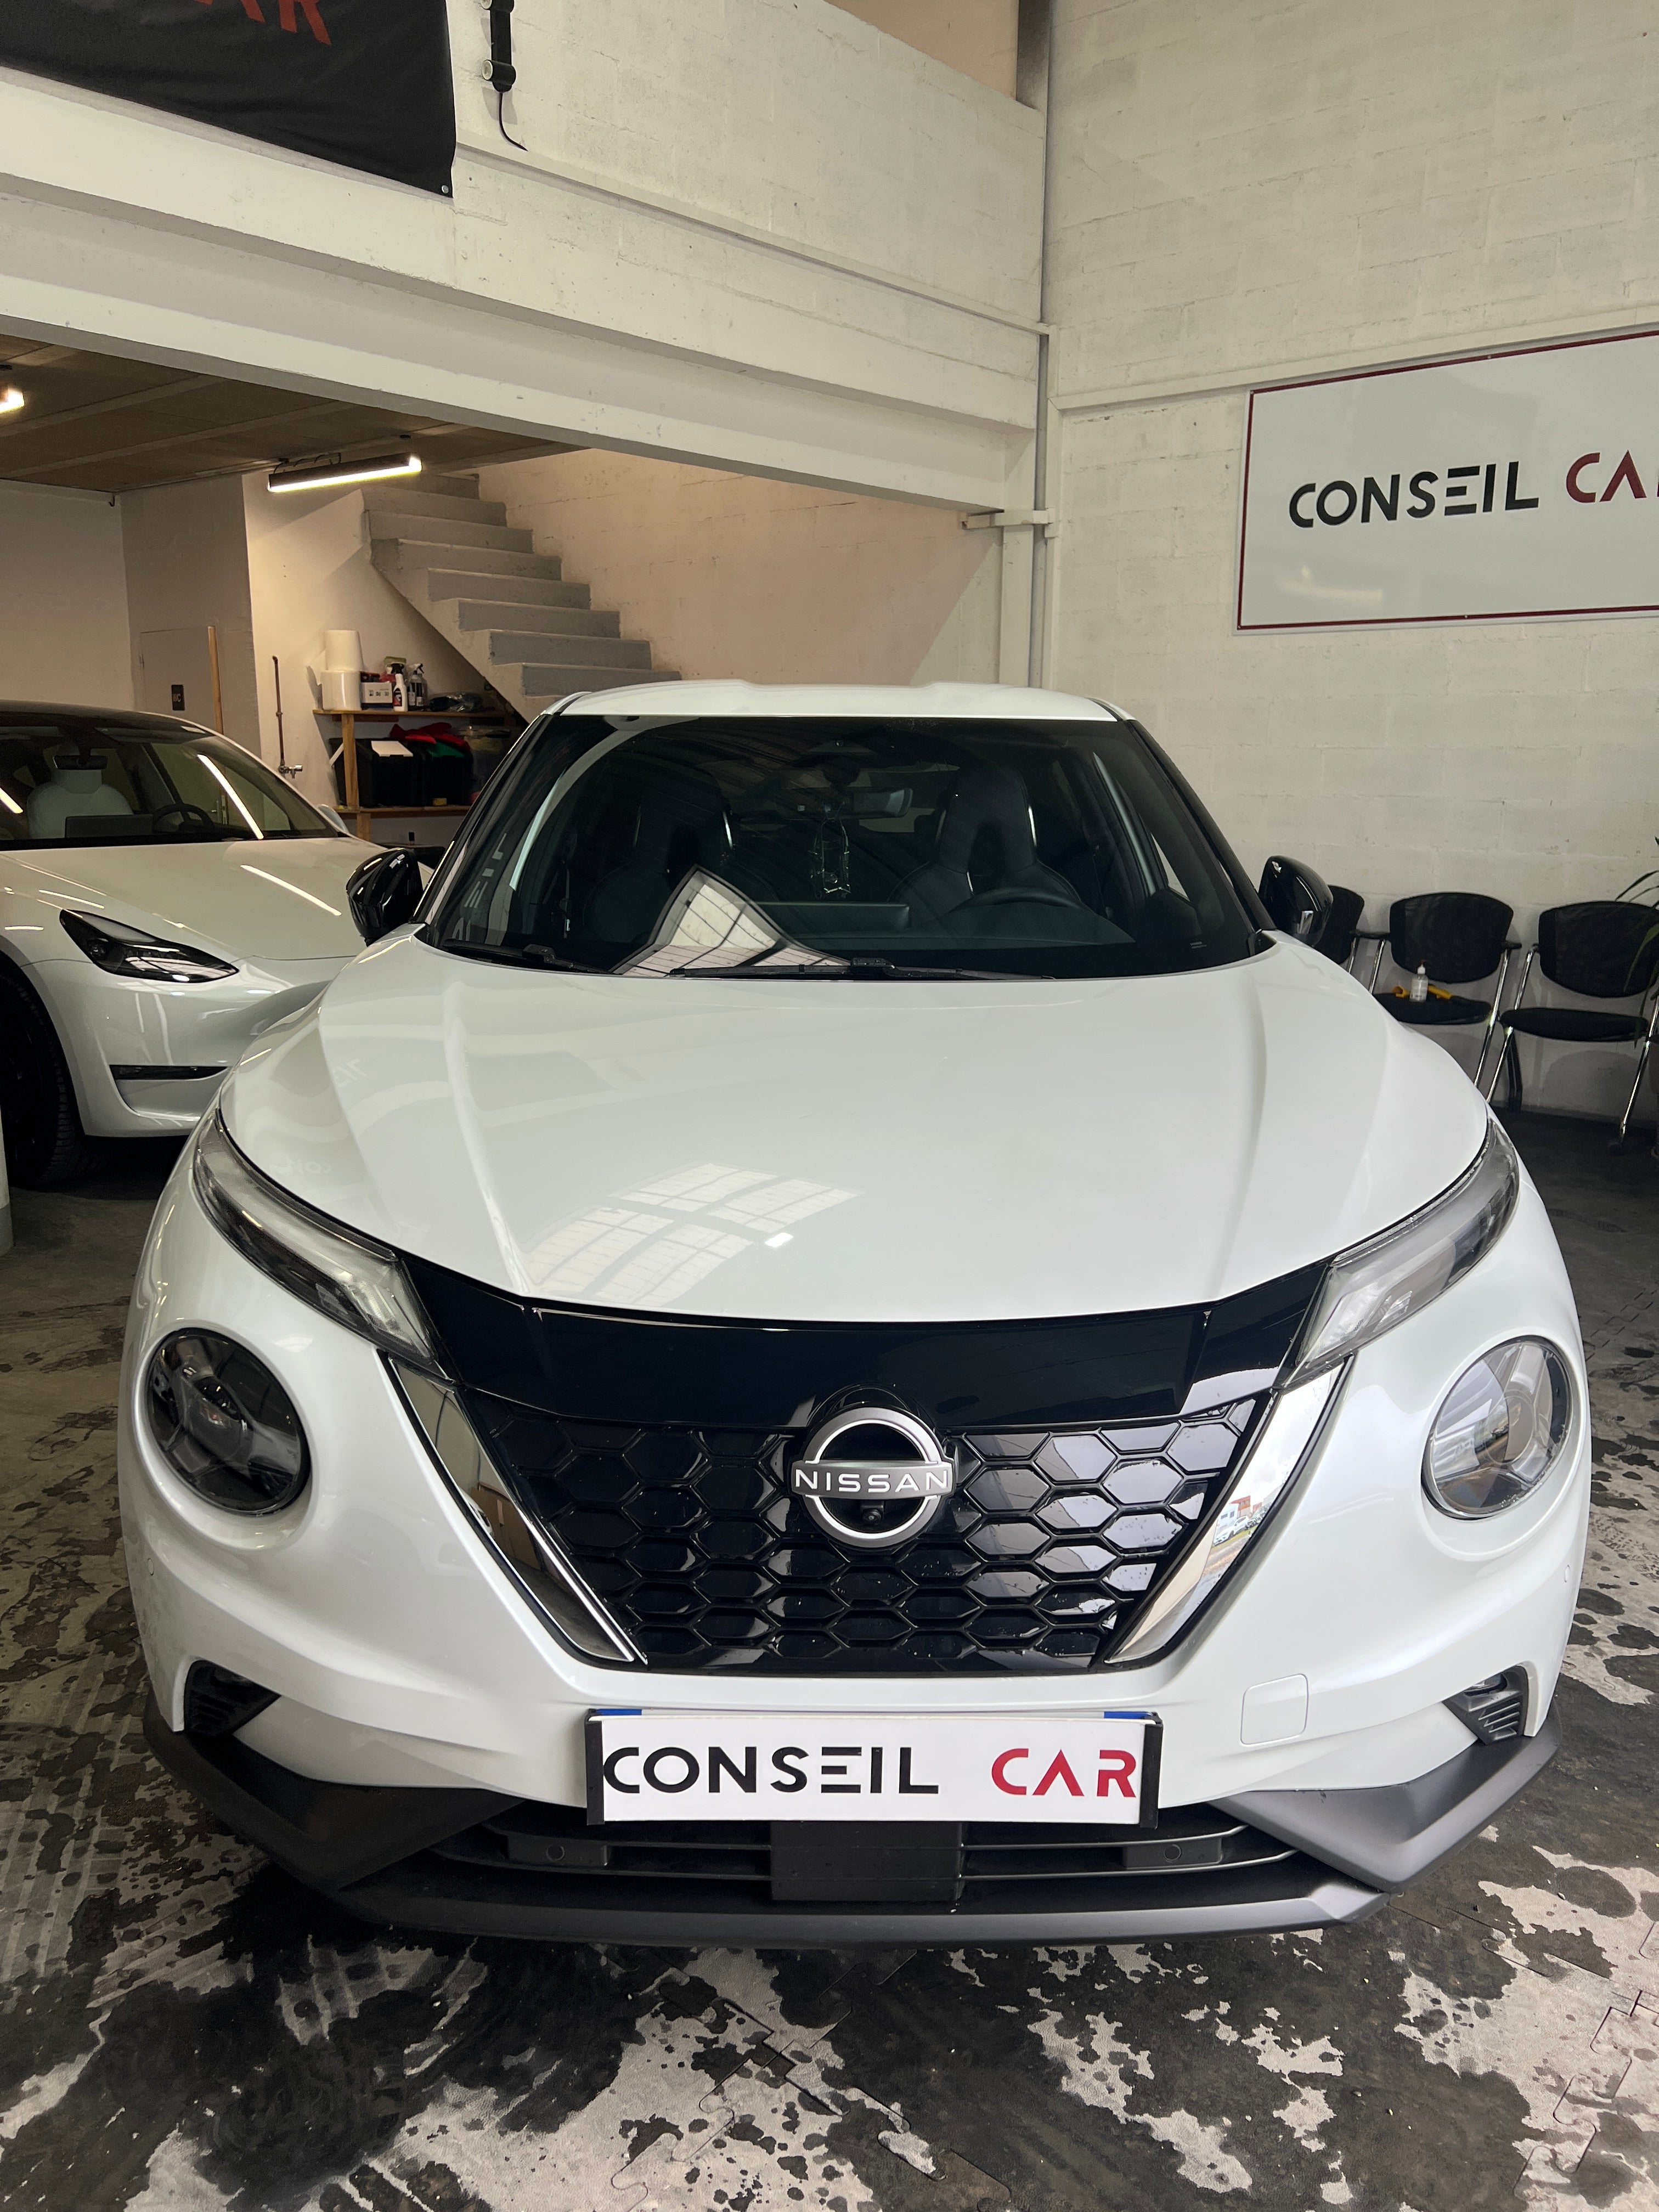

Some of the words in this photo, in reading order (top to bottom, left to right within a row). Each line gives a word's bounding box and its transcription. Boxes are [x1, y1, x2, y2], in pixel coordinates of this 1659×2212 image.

[1289, 461, 1539, 528] CONSEIL
[1566, 450, 1659, 504] CA
[795, 1469, 947, 1493] NISSAN
[603, 1747, 939, 1794] CONSEIL
[991, 1748, 1136, 1798] CAR
